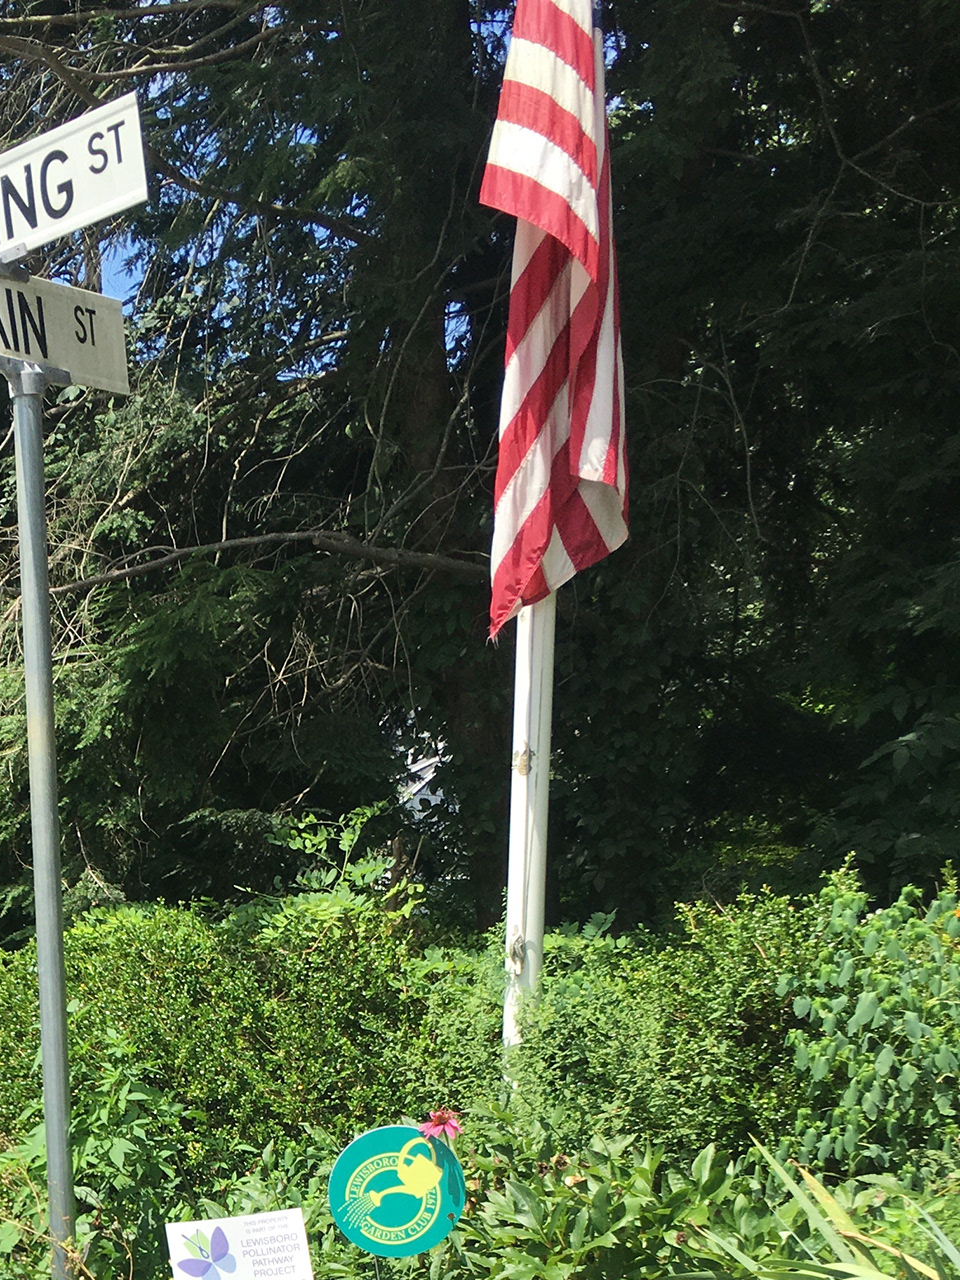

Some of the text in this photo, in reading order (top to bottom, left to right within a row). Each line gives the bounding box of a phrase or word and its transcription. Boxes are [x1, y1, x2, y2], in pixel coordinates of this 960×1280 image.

[88, 119, 125, 174] ST
[74, 305, 96, 347] ST
[349, 1156, 398, 1198] LEWISBORO
[257, 1216, 288, 1225] PROPERTY
[361, 1220, 407, 1241] GARDEN
[407, 1212, 432, 1235] CLUB
[240, 1232, 298, 1248] LEWISBORO
[242, 1243, 301, 1258] POLLINATOR
[252, 1254, 294, 1267] PATHWAY
[253, 1265, 296, 1278] PROJECT
